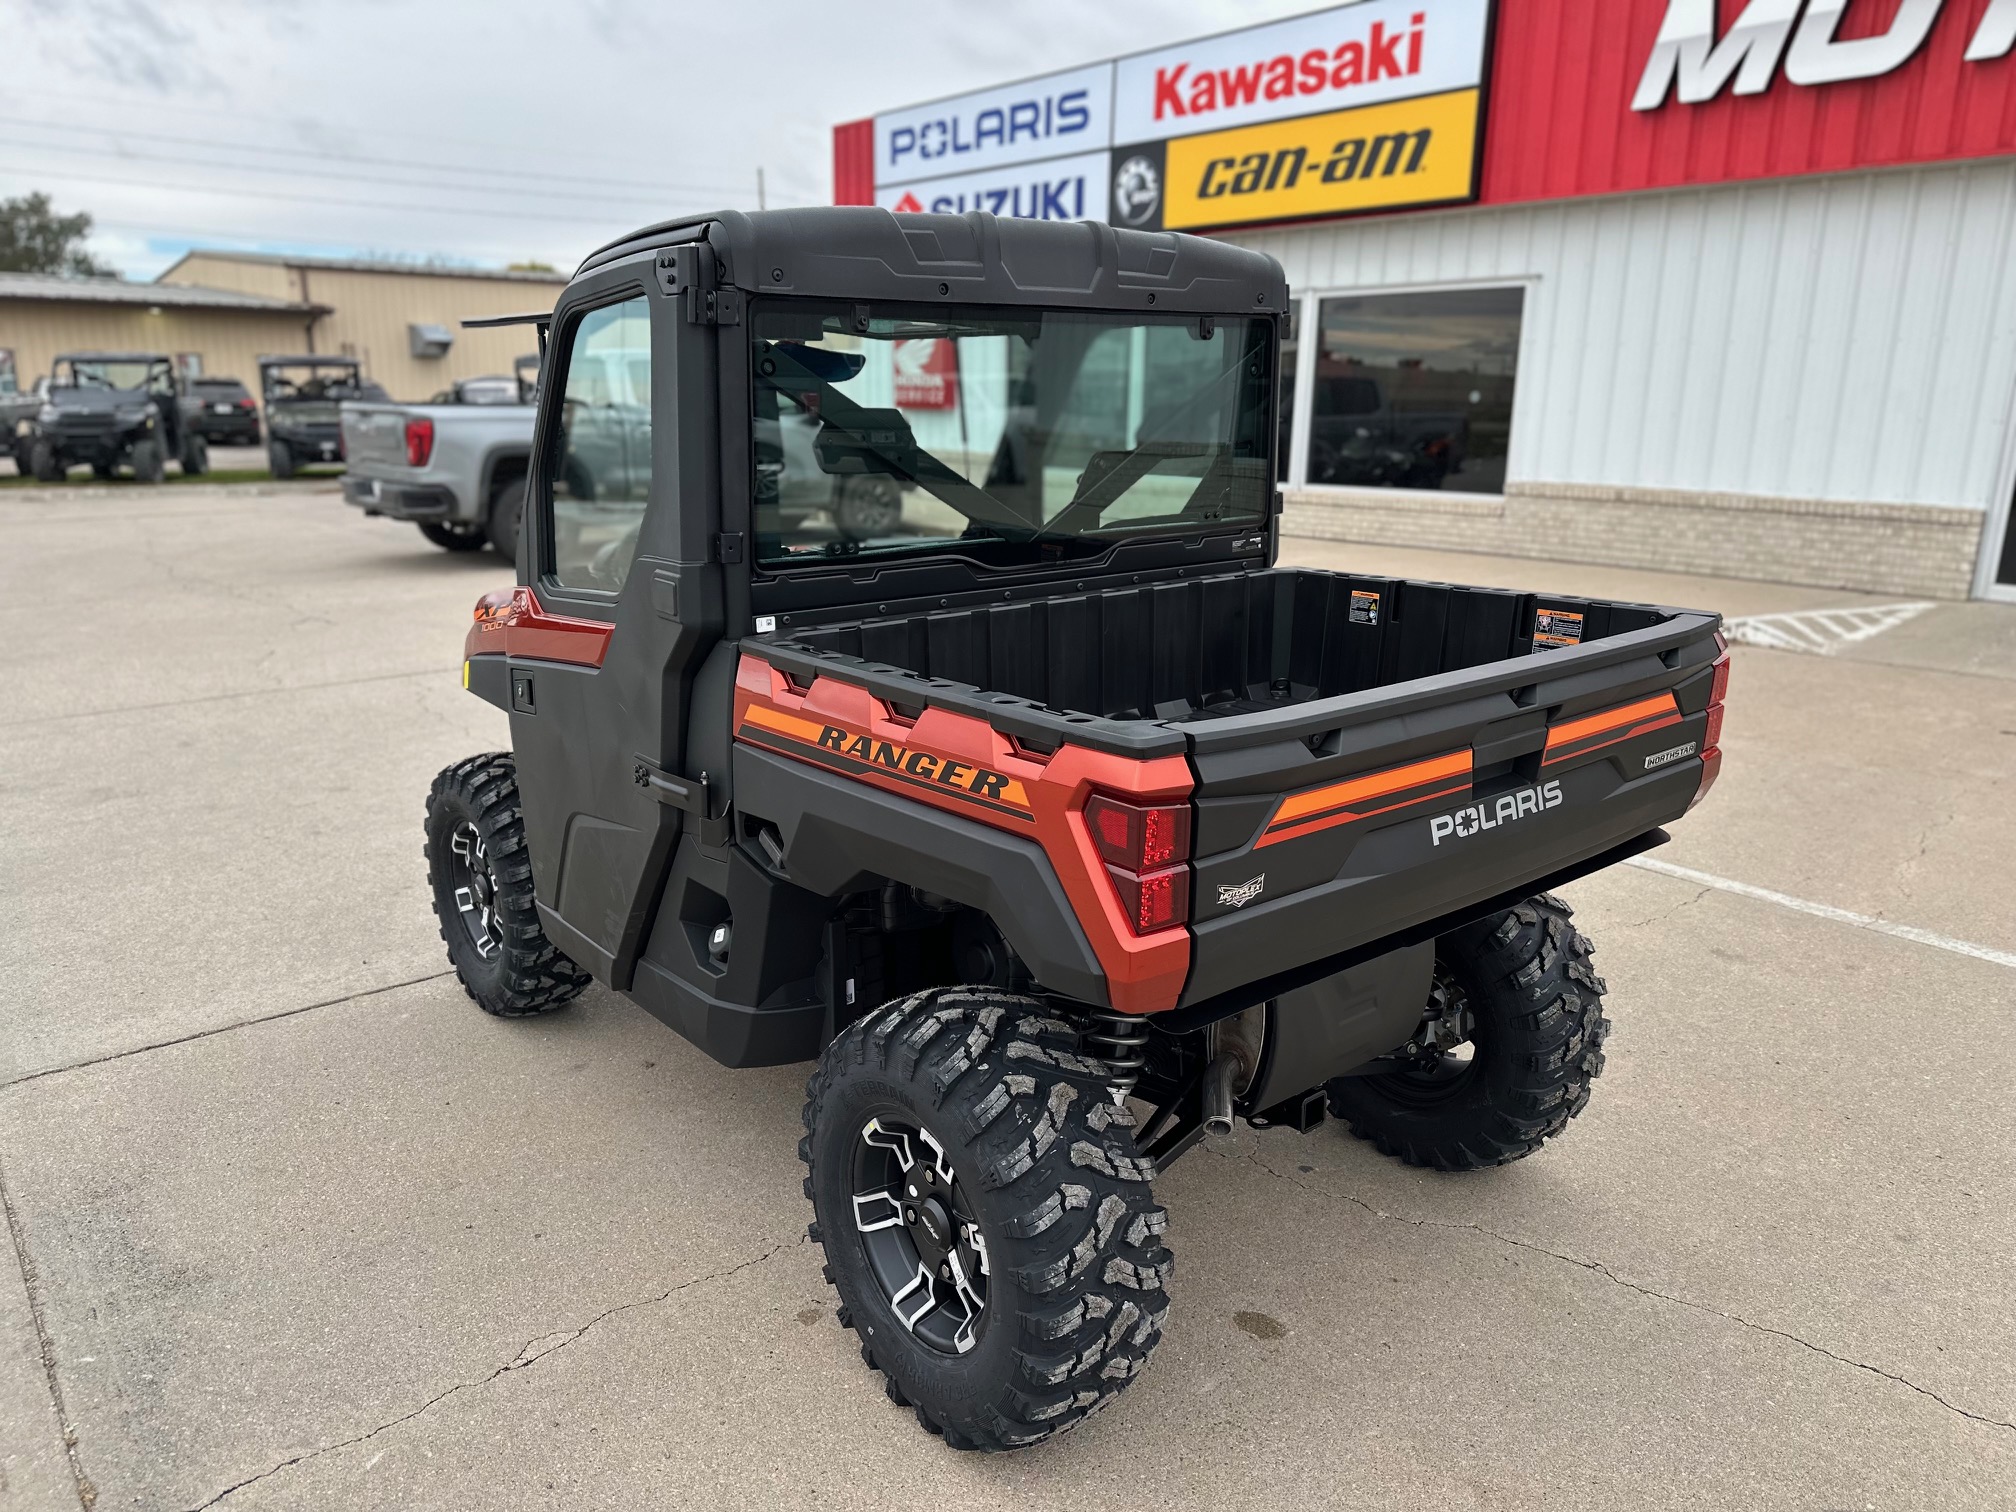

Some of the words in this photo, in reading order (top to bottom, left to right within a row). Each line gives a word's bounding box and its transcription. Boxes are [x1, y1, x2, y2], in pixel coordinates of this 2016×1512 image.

[1153, 11, 1426, 121] Kawasaki
[890, 89, 1091, 166] POLARIS
[1197, 128, 1432, 199] can-am
[816, 724, 1010, 801] RANGER
[1649, 745, 1694, 766] NORTHSTAR
[1430, 780, 1563, 846] POLARIS
[1219, 882, 1262, 901] MOTOPLEX
